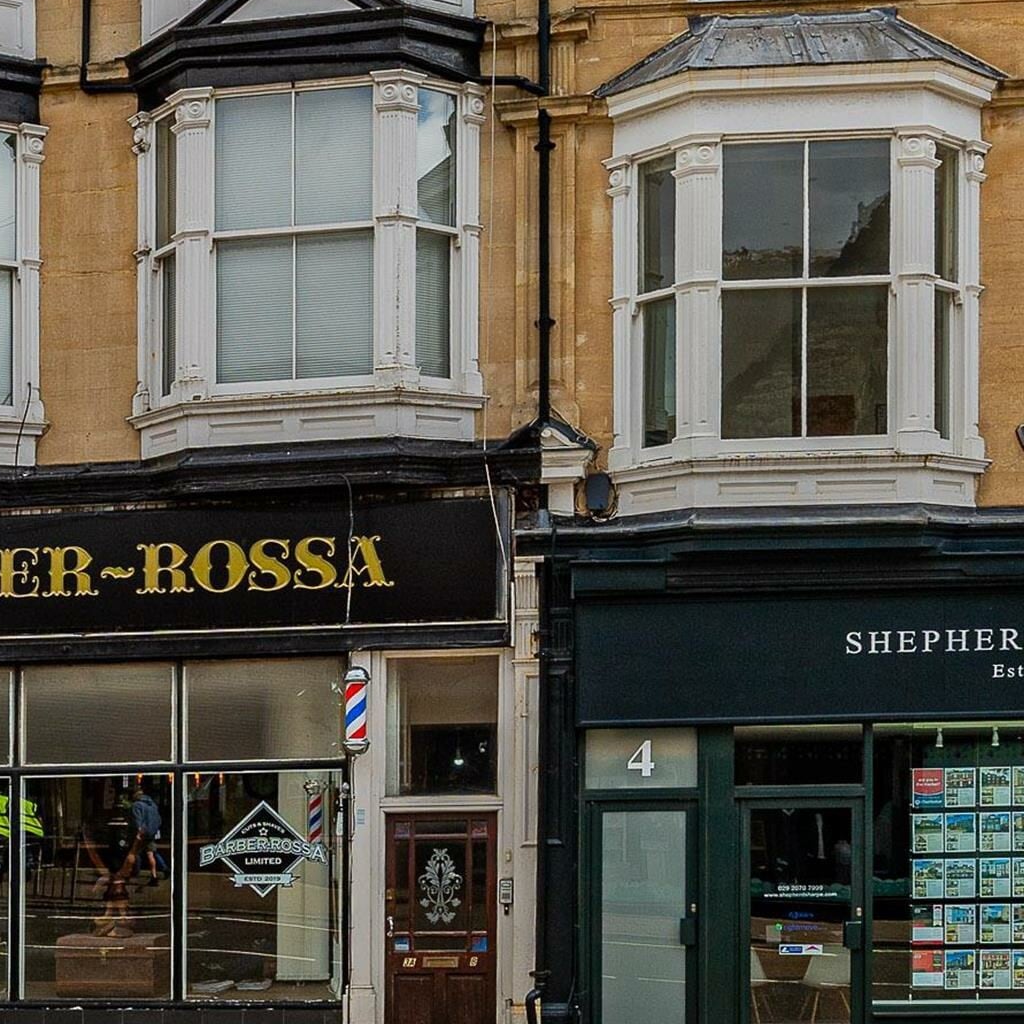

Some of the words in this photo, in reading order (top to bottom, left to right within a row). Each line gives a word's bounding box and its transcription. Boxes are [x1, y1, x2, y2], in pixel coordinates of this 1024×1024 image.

[845, 628, 1023, 655] SHEPHER
[627, 739, 655, 777] 4
[241, 823, 256, 834] CUTS
[262, 822, 285, 834] SHAVES
[245, 857, 282, 865] LIMITED
